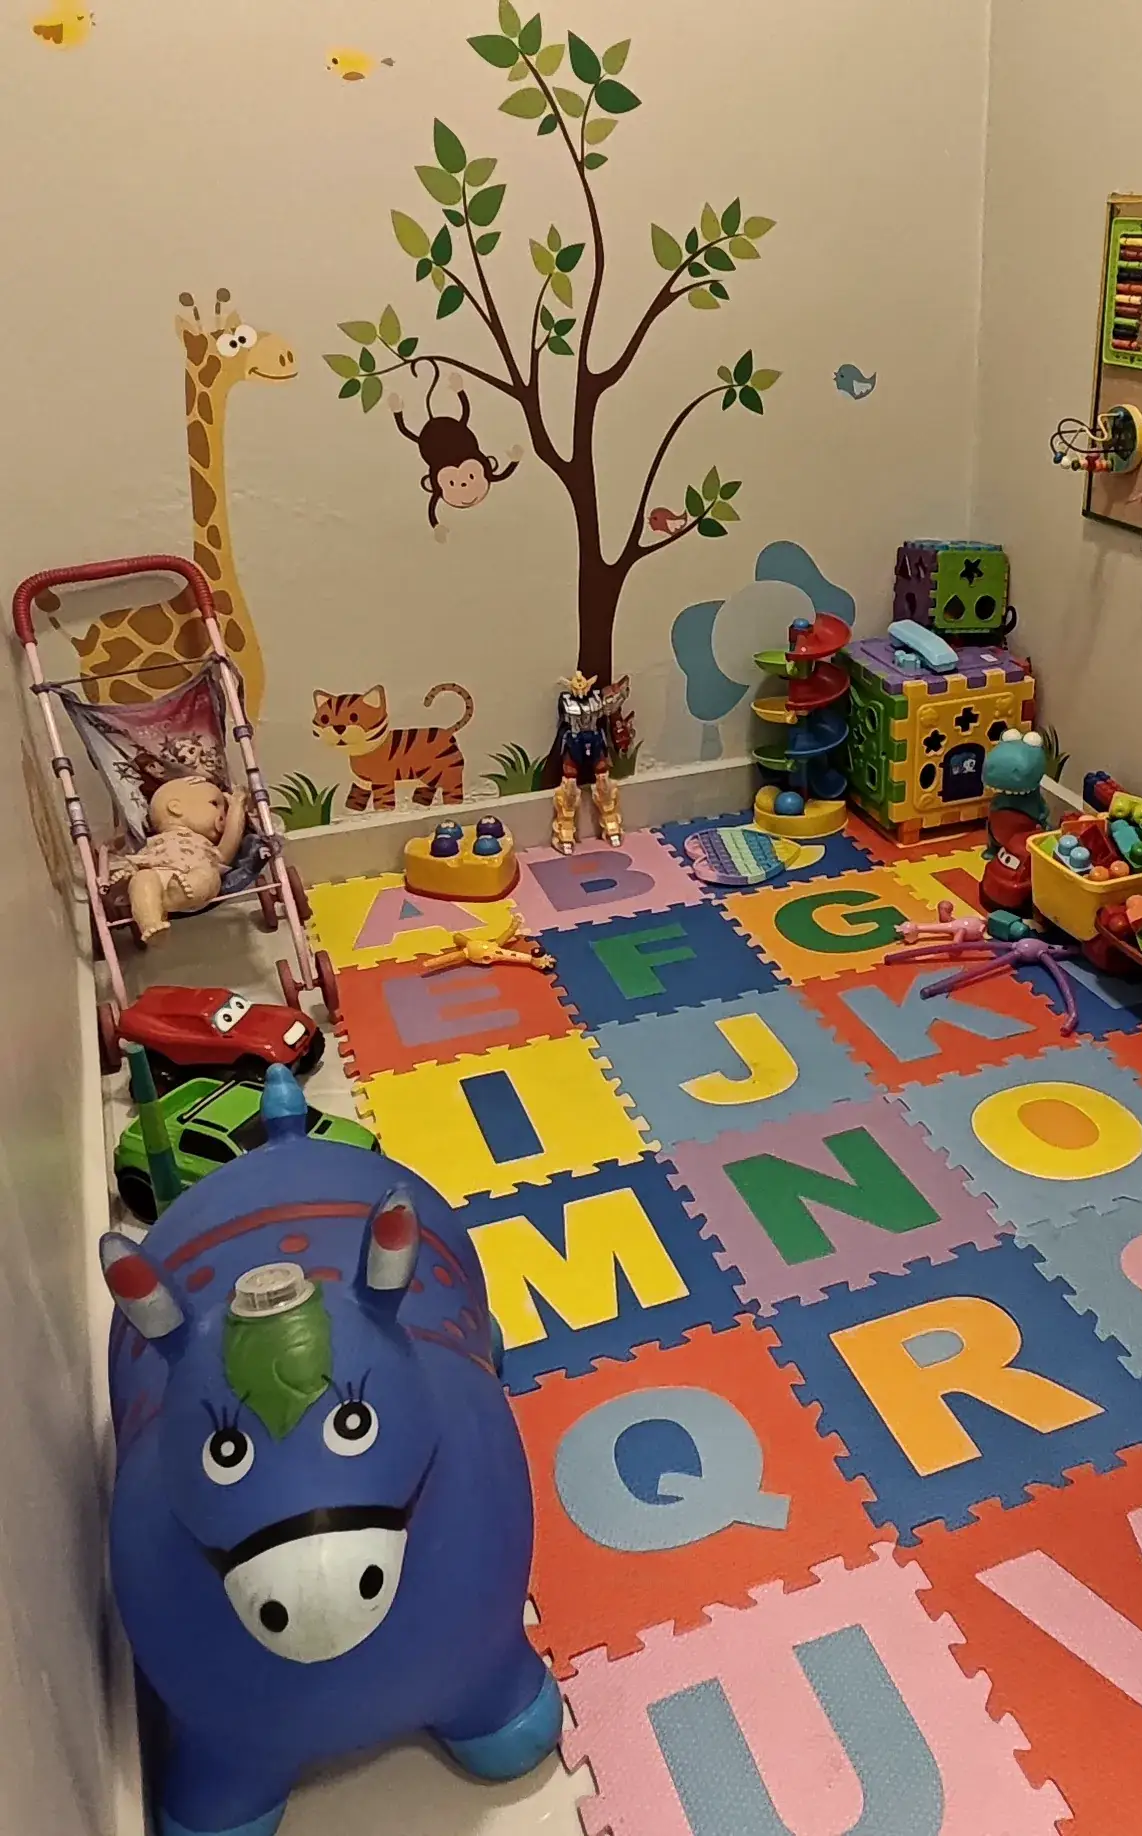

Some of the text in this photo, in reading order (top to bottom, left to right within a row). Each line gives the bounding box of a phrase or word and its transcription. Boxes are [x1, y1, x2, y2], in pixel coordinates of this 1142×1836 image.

[352, 886, 489, 950] A
[525, 850, 655, 912] B
[774, 889, 911, 954] G
[381, 966, 521, 1047] E
[589, 921, 698, 1000] F
[678, 1012, 799, 1104] J
[839, 966, 1037, 1063] K
[458, 1069, 546, 1165] I
[722, 1125, 942, 1267] N
[468, 1187, 690, 1351] M
[828, 1295, 1107, 1478] R
[553, 1386, 791, 1553] Q
[646, 1623, 946, 1836] U
